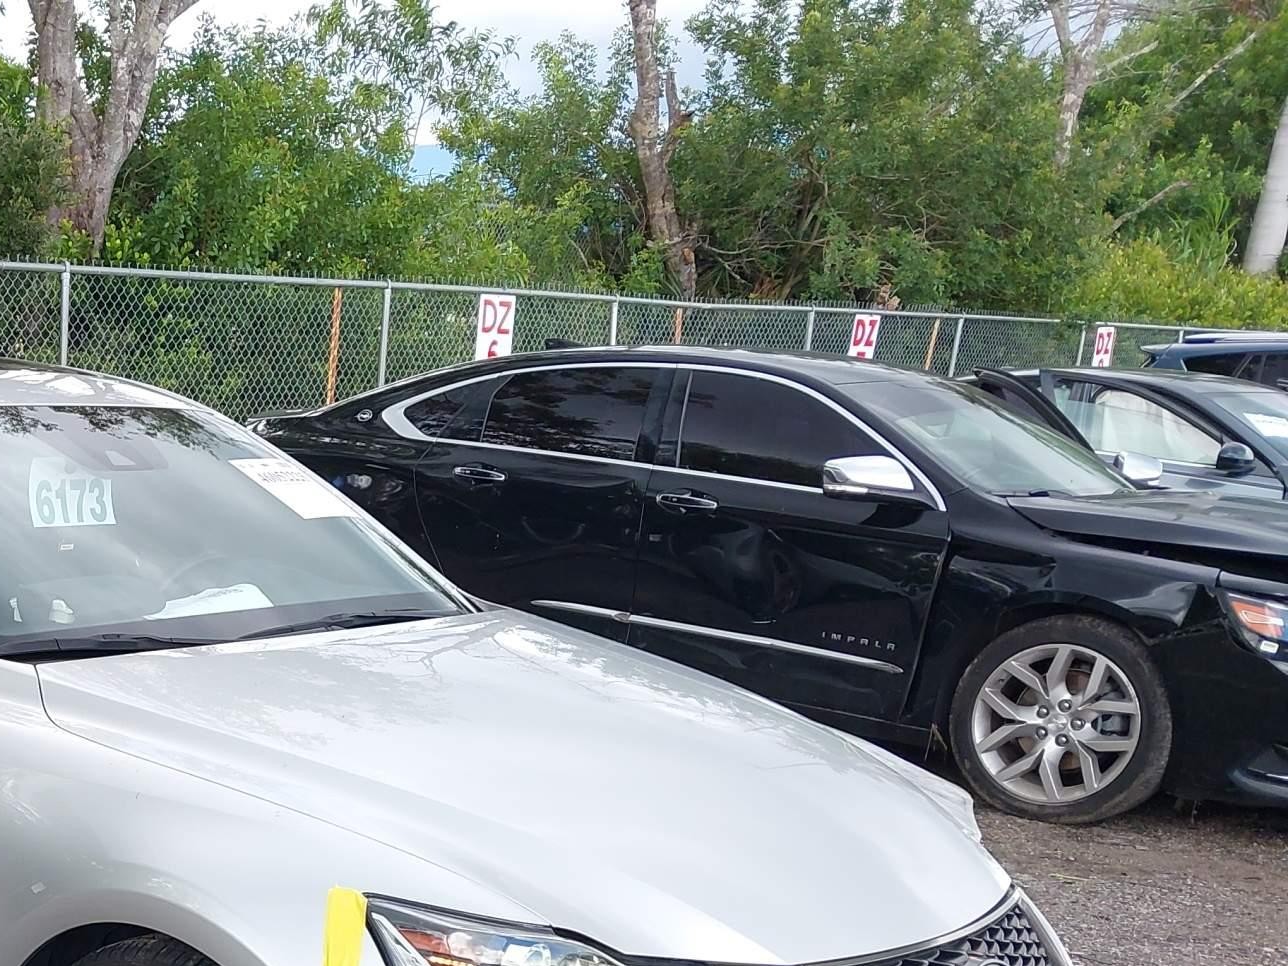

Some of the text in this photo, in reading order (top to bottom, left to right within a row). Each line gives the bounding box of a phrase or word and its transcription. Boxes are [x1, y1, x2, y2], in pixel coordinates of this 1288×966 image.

[482, 298, 513, 334] DZ
[853, 319, 878, 347] DZ
[1096, 332, 1112, 355] DZ
[36, 479, 107, 524] 6173
[822, 631, 896, 651] IMPALA
